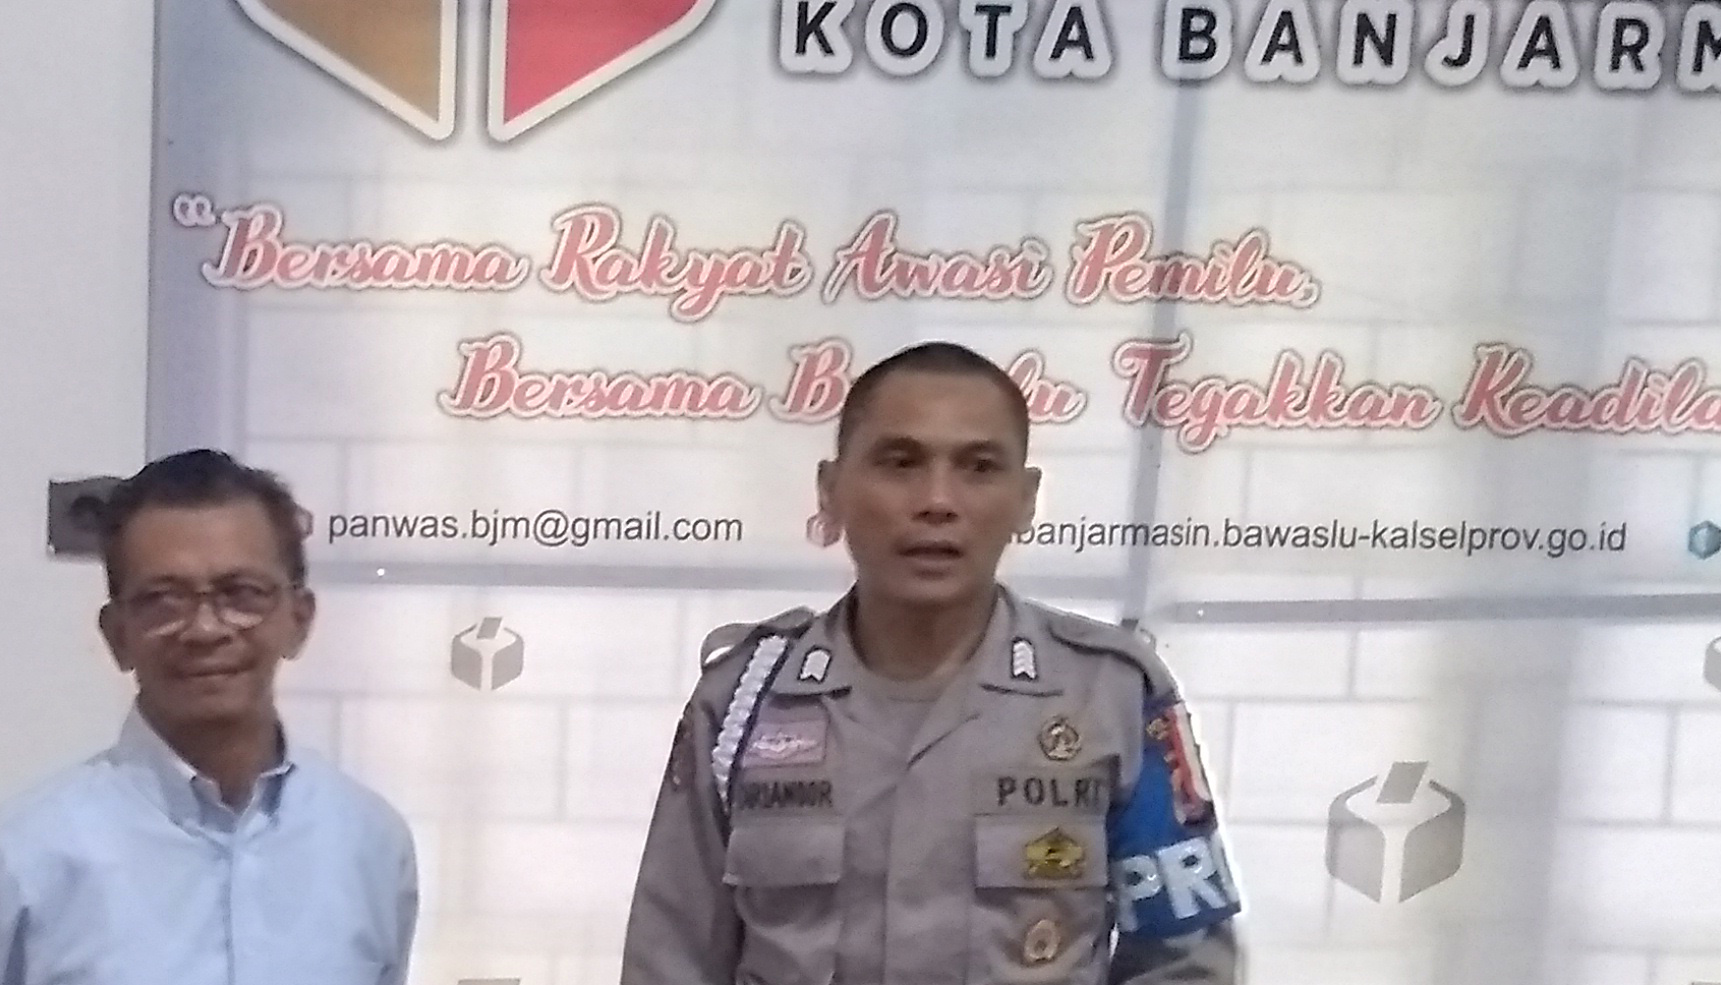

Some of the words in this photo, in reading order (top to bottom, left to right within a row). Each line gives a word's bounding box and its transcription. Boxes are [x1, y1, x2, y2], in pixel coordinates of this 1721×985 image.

[788, 0, 1098, 62] KOTA
[540, 203, 810, 324] Rakyat
[822, 211, 1056, 304] Awasi
[1063, 212, 1322, 308] Pemilu,
[438, 332, 763, 422] Bersama
[1112, 333, 1443, 457] Tegakkan
[327, 509, 745, 546] panwas.bjm@gmail.com
[1113, 836, 1236, 934] PR
